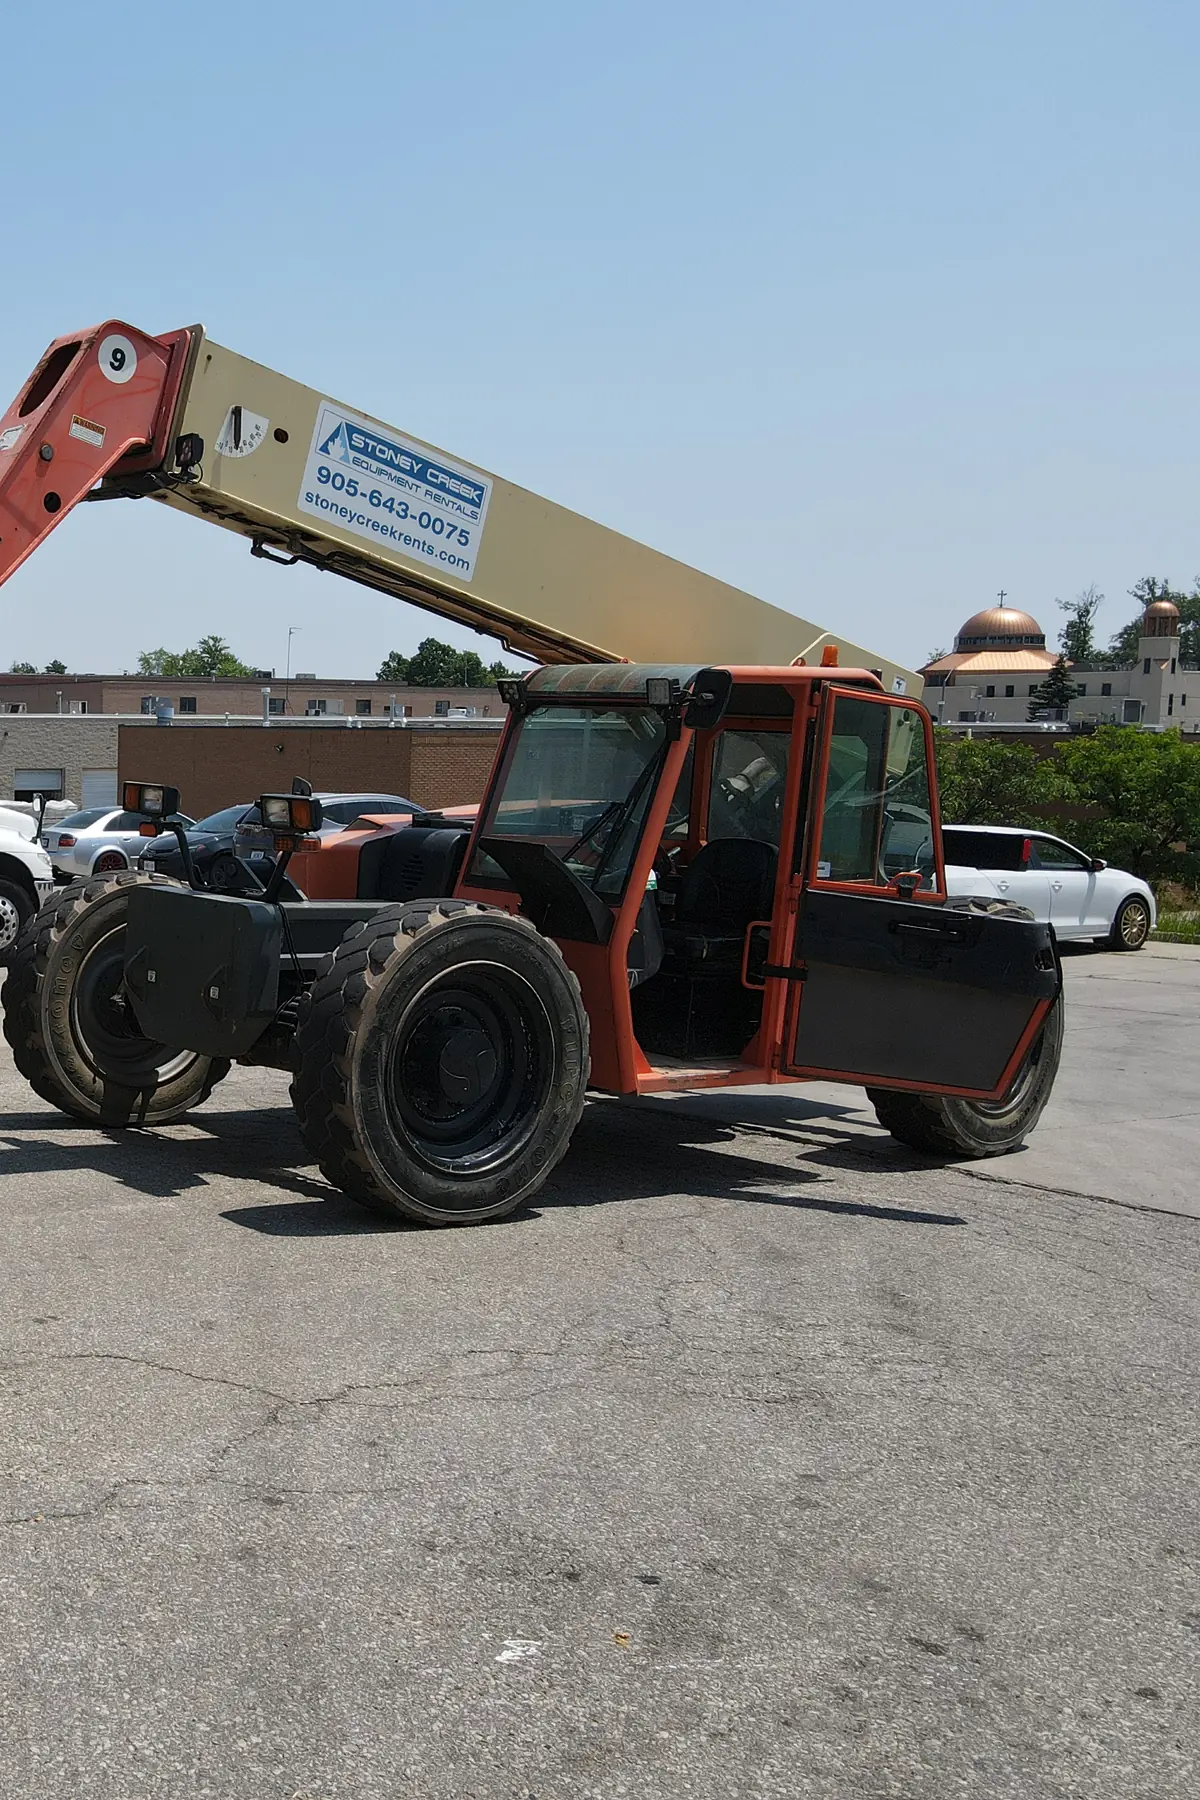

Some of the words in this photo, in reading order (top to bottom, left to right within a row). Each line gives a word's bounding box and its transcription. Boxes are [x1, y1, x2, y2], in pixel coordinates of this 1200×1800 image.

[108, 347, 126, 372] 9
[351, 432, 423, 474] STONEY
[426, 468, 483, 503] CREEK
[352, 456, 421, 493] EQUIPMENT
[424, 490, 479, 520] RENTALS
[305, 490, 470, 571] stoneycreekrents.com
[316, 465, 471, 547] 905-643-0075
